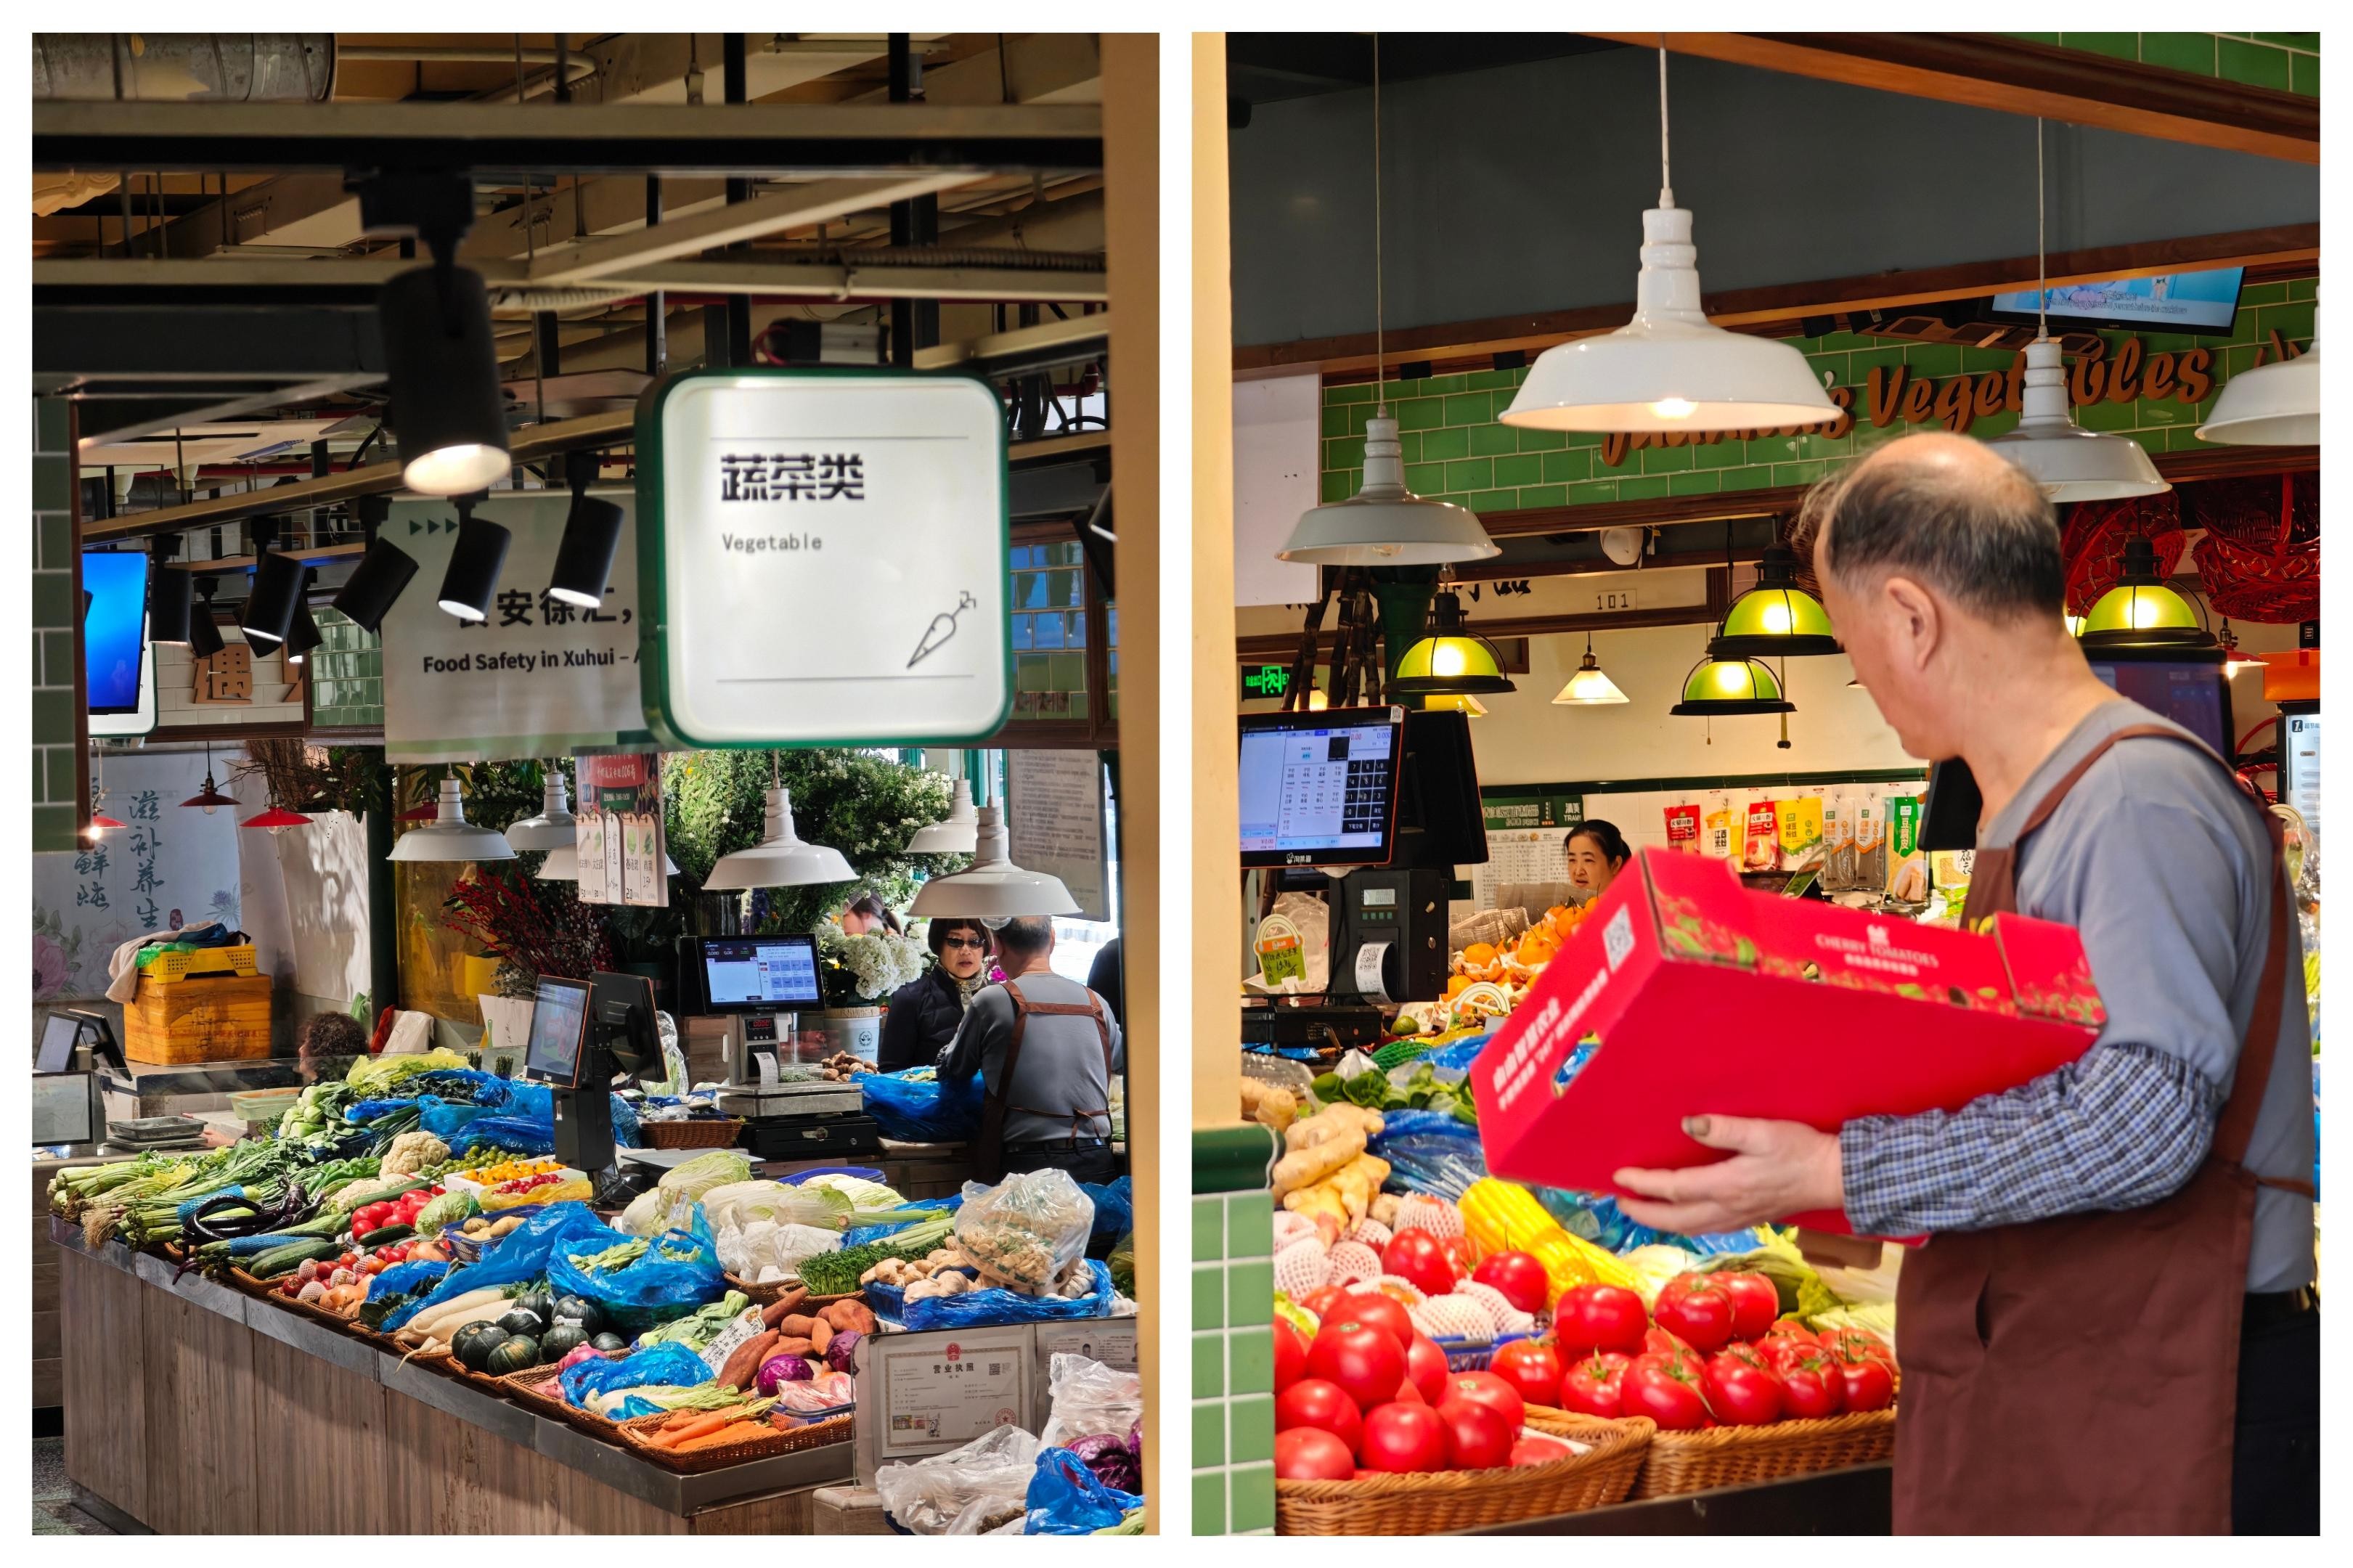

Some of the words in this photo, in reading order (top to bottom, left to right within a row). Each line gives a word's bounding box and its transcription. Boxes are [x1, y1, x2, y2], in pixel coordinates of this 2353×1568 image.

[1867, 338, 2214, 434] Vegetbles
[720, 453, 865, 502] 蔬菜类
[722, 532, 823, 553] Vegetable
[423, 654, 470, 672] Food
[476, 651, 536, 672] Safety
[541, 650, 558, 668] in
[563, 648, 614, 666] Xuhui
[1714, 829, 1727, 839] 江西
[1714, 838, 1727, 848] 米粉
[129, 790, 164, 928] 滋补养生
[933, 1363, 974, 1374] 营业执照
